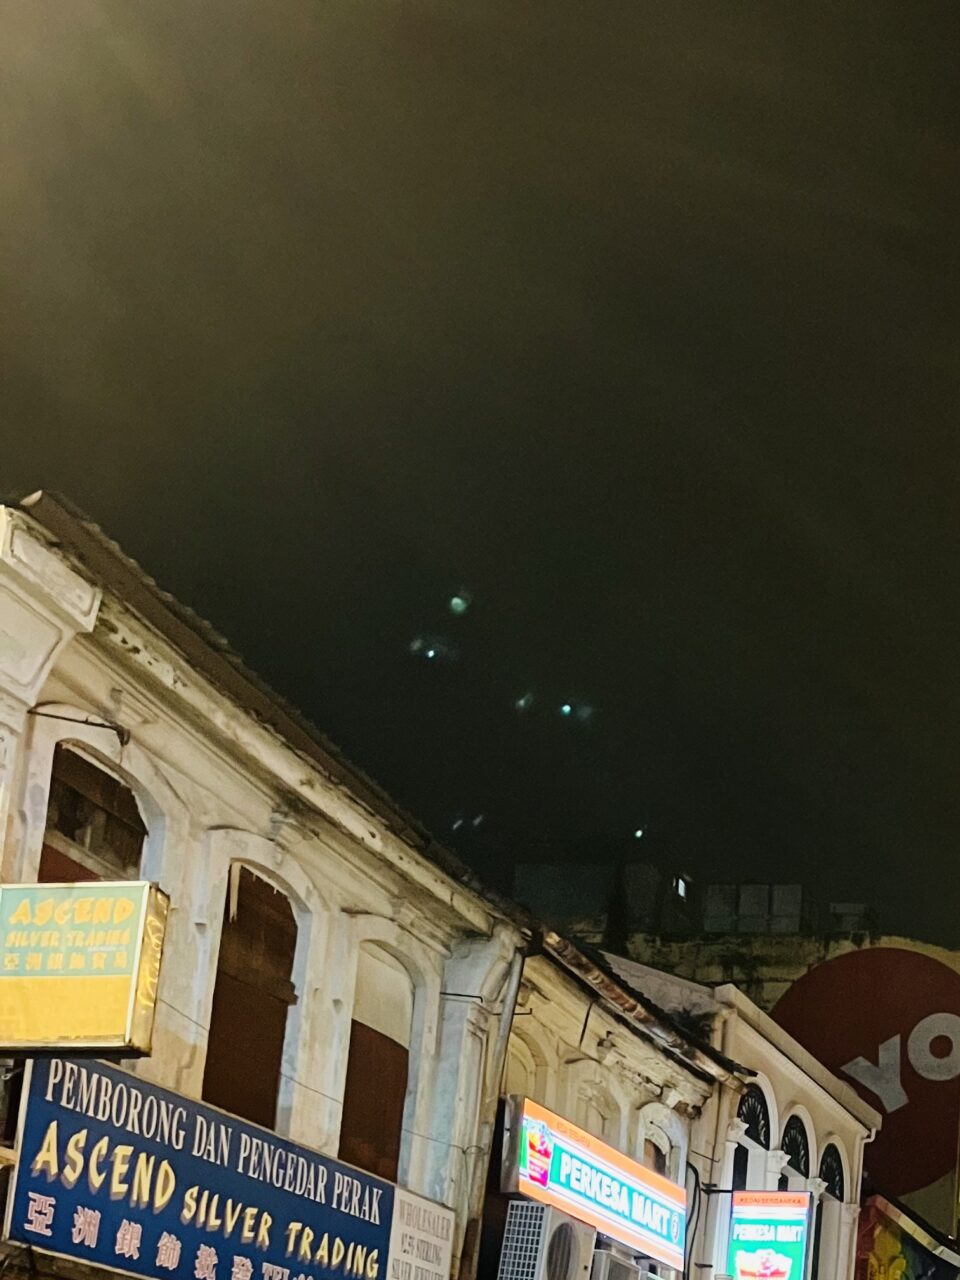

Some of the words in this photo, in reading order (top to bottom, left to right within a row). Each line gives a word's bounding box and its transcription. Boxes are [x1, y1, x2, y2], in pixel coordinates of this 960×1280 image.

[9, 897, 135, 926] ASCEND
[31, 1120, 177, 1215] ASCEND
[181, 1185, 273, 1252] SILVER
[45, 1058, 187, 1150] PEMBORONG
[192, 1115, 232, 1168] DAN
[237, 1133, 328, 1205] PENGEDAR
[331, 1172, 383, 1226] PERAK
[559, 1151, 630, 1217] PERKESA
[631, 1192, 672, 1238] MART
